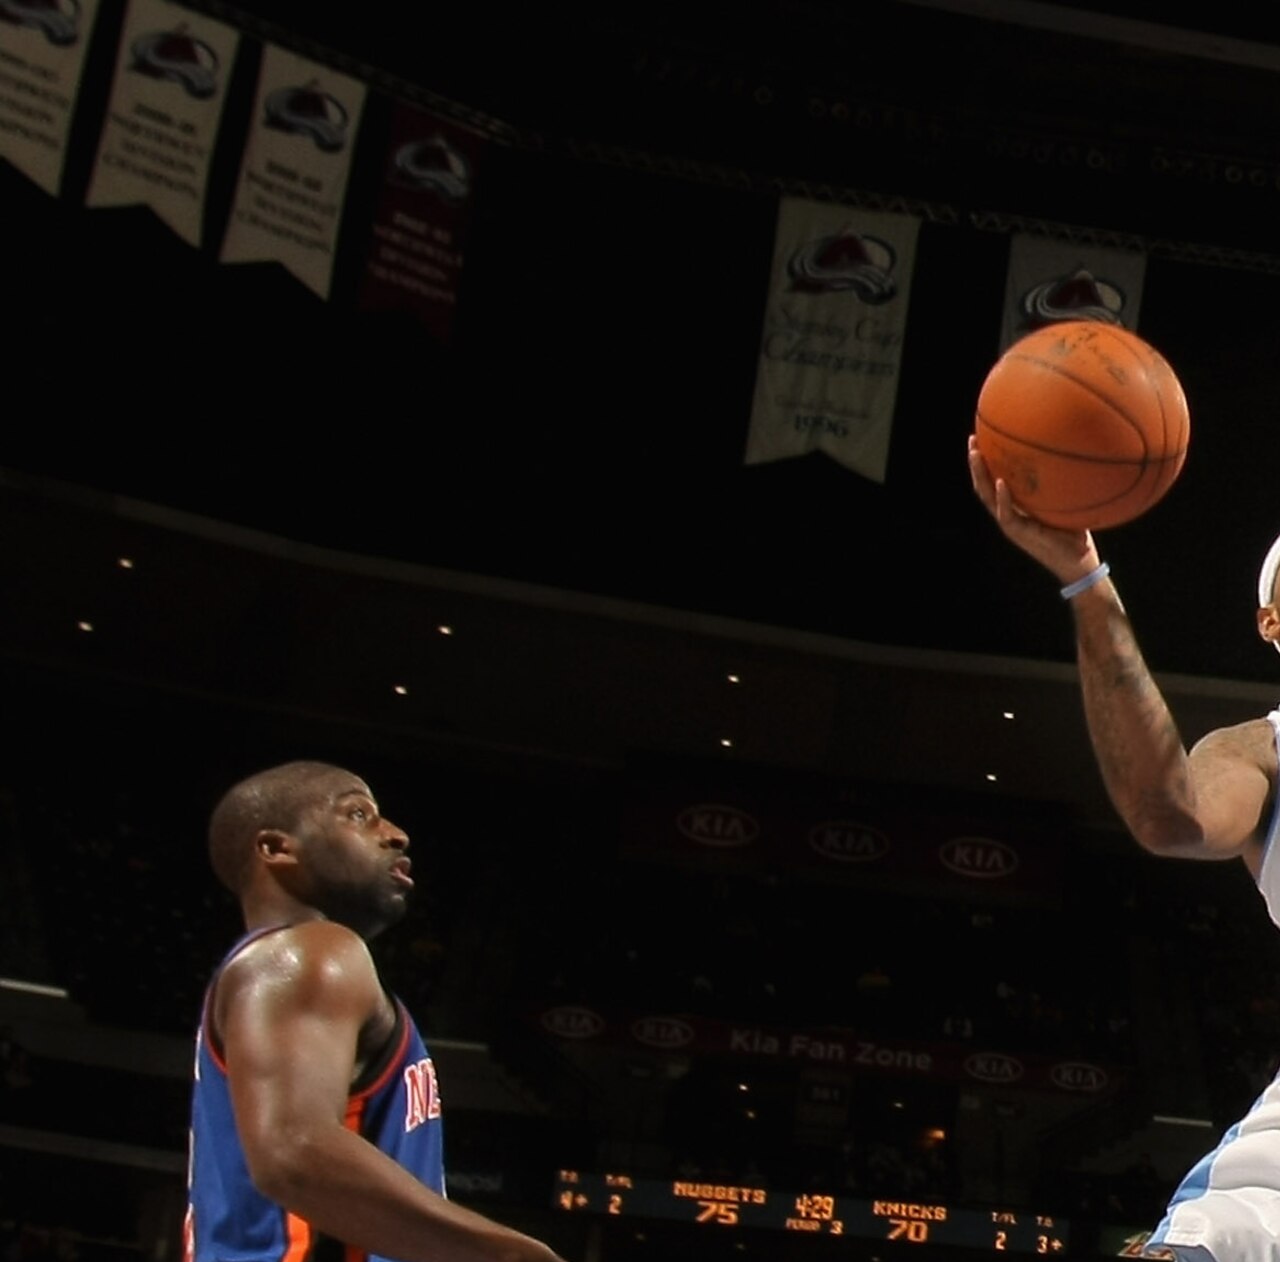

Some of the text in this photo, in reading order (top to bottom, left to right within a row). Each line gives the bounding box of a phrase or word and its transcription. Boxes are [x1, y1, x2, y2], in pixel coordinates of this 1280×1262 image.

[730, 1027, 934, 1072] Kia Fan Zone
[607, 1193, 623, 1216] 2
[673, 1180, 768, 1206] NUGGETS
[695, 1201, 740, 1226] 75
[794, 1192, 836, 1221] 4:29
[872, 1200, 948, 1222] KNICKS
[886, 1219, 930, 1244] 70
[994, 1229, 1009, 1252] 2
